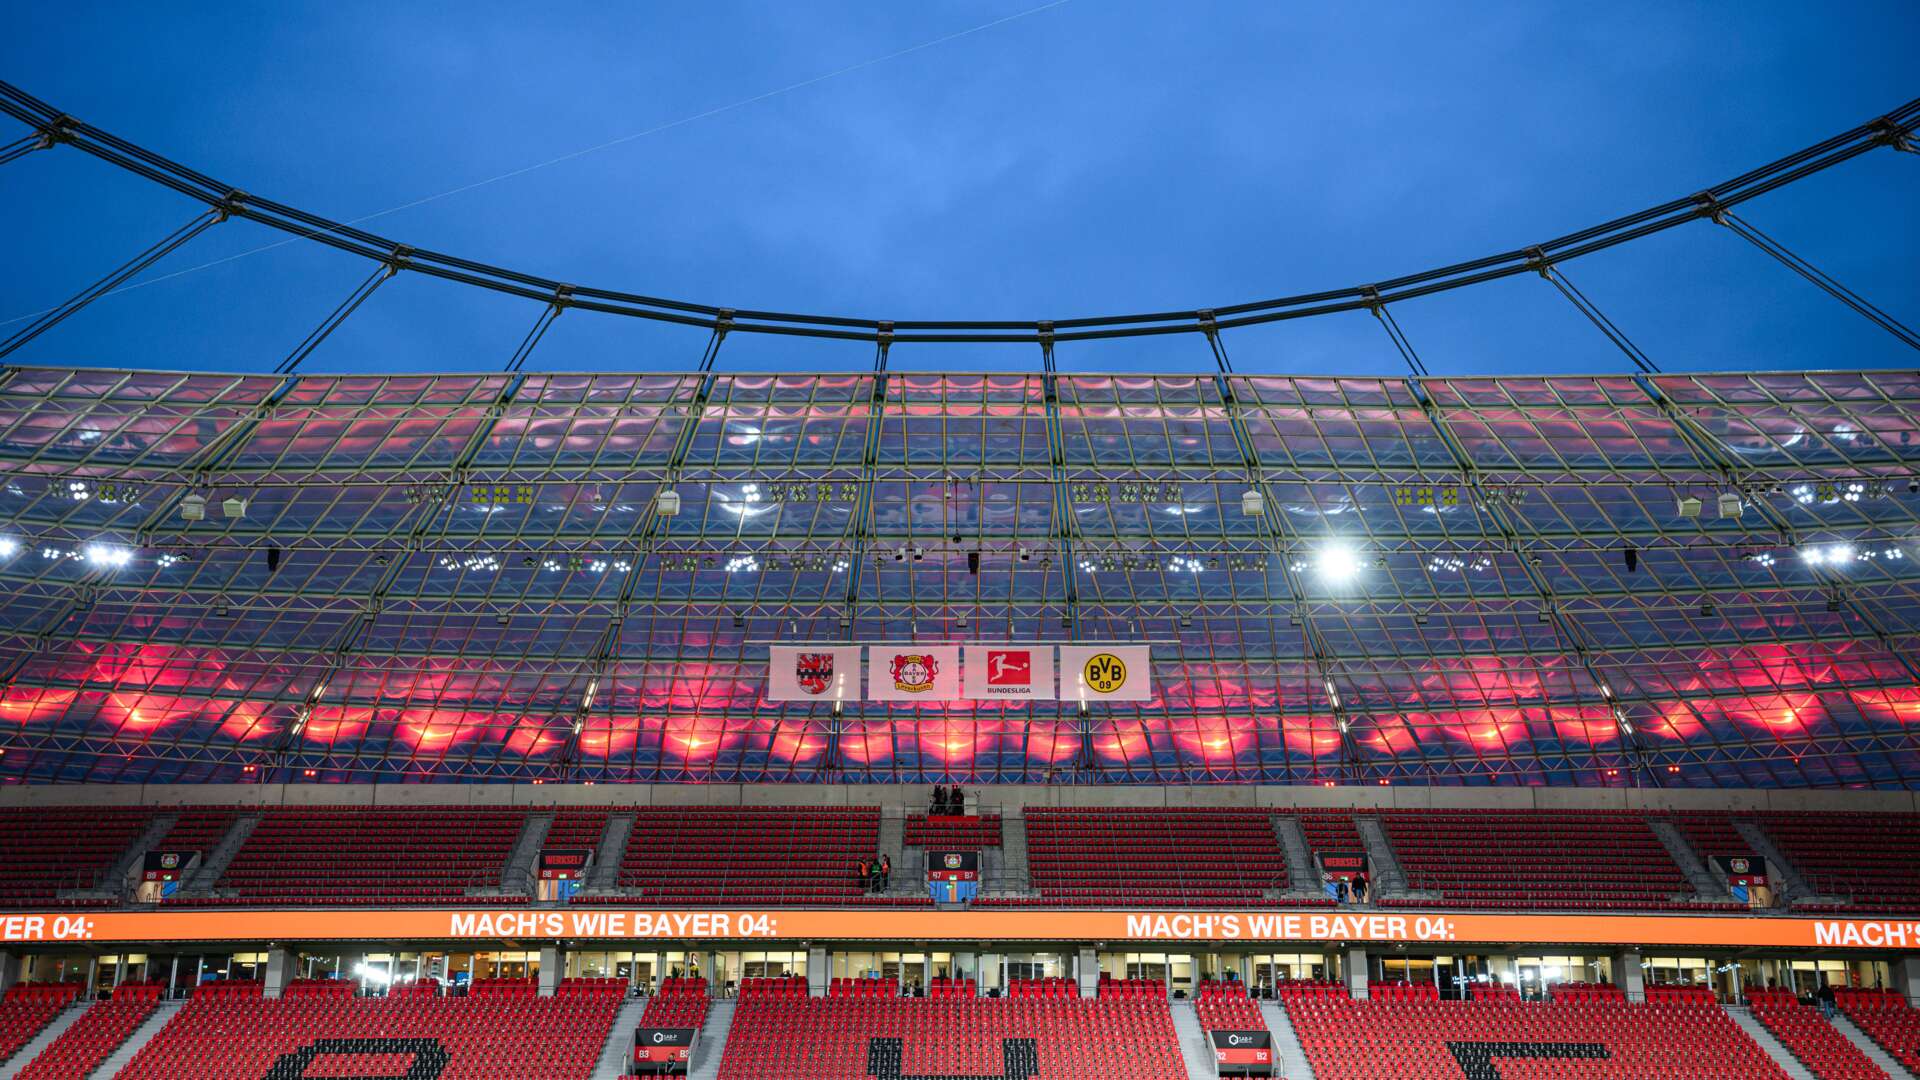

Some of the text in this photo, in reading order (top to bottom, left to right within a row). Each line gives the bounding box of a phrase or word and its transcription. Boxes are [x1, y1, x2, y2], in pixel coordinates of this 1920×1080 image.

[1090, 657, 1122, 681] BVB
[1099, 680, 1112, 690] 09
[545, 855, 584, 865] WERKSELF
[964, 871, 974, 879] B7
[52, 915, 94, 939] 04:
[450, 912, 777, 937] MACH'S WIE BAYER 04:
[1126, 913, 1455, 940] MACH'S WIE BAYER 04:
[639, 1049, 649, 1058] B3
[1256, 1051, 1267, 1060] B2
